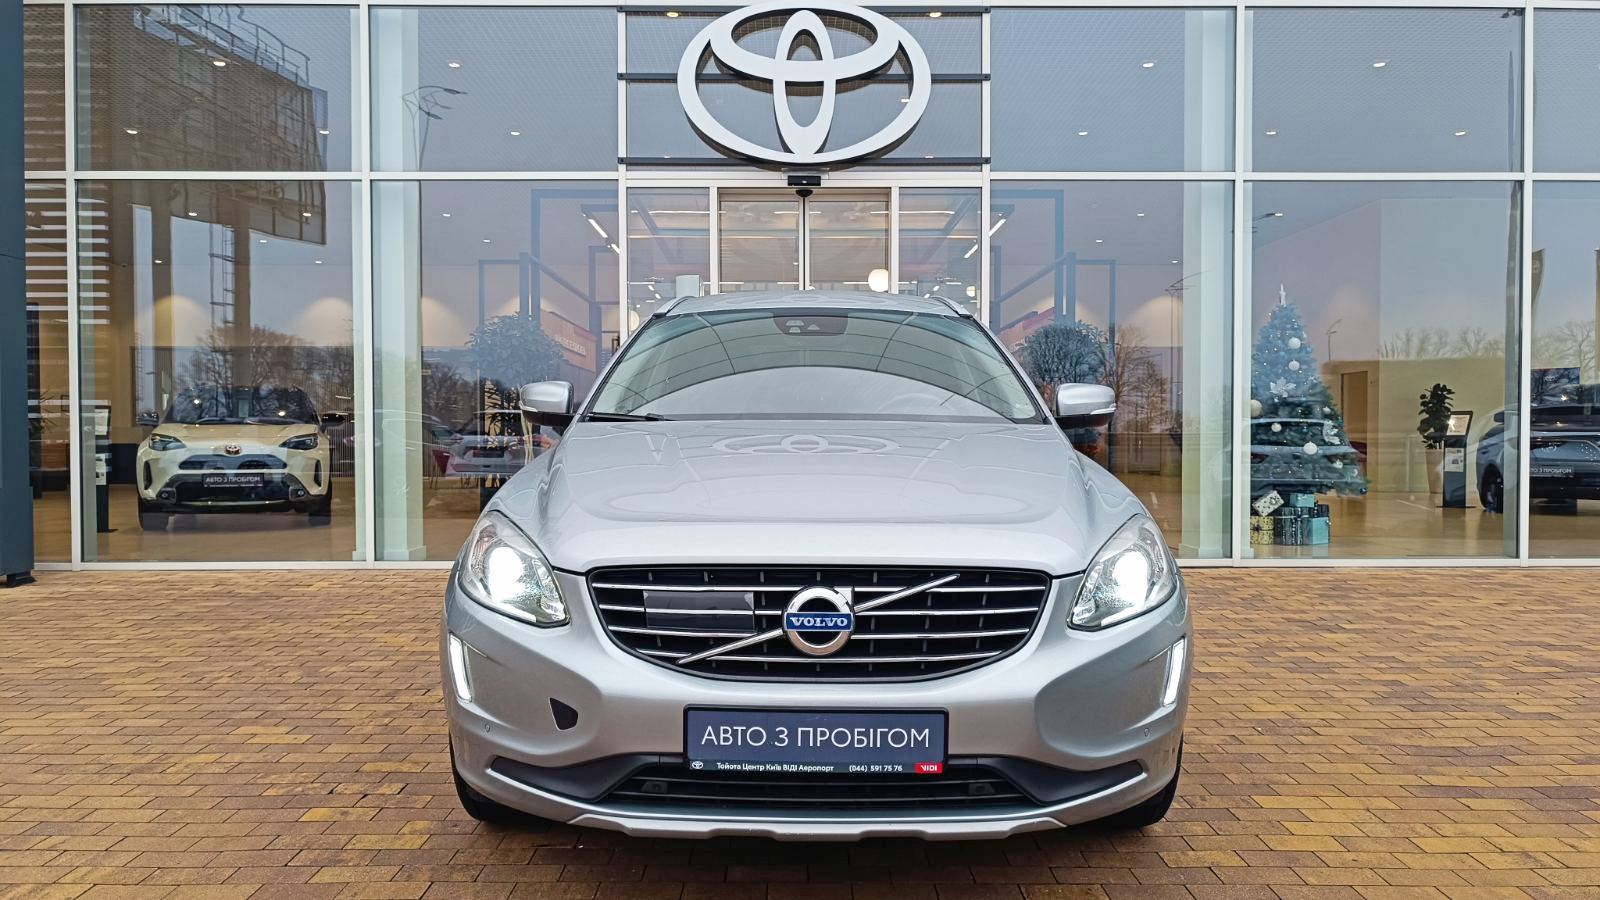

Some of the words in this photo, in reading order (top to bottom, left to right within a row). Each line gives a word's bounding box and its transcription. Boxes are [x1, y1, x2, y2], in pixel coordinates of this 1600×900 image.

[790, 616, 848, 627] VOLVO
[701, 725, 767, 746] АВТО
[774, 727, 789, 746] З
[797, 727, 930, 747] ПРОБІГОМ
[716, 762, 741, 770] Тойота
[742, 763, 765, 771] Центр
[766, 763, 782, 771] Київ
[783, 764, 798, 772] ВІДІ
[798, 764, 834, 772] Аеропорт
[849, 764, 868, 773] (044)
[920, 764, 937, 772] VIDI
